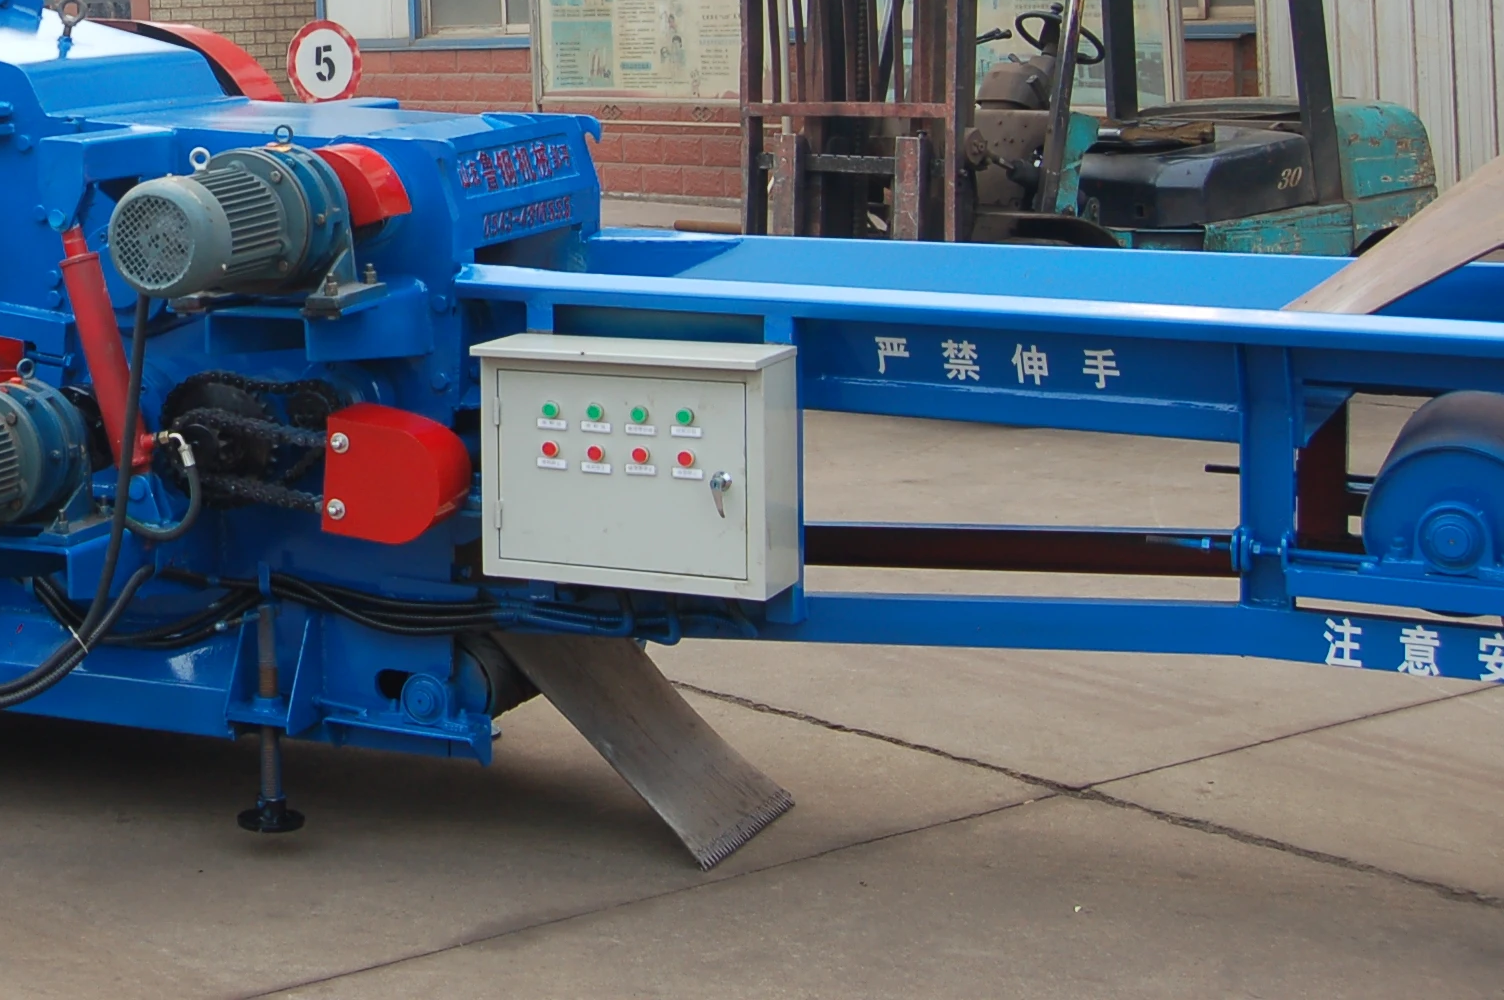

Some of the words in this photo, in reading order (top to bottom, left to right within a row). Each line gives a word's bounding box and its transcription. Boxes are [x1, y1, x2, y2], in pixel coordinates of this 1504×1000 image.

[315, 44, 335, 81] 5
[1277, 166, 1303, 190] 30
[874, 335, 1121, 390] 严禁伸手
